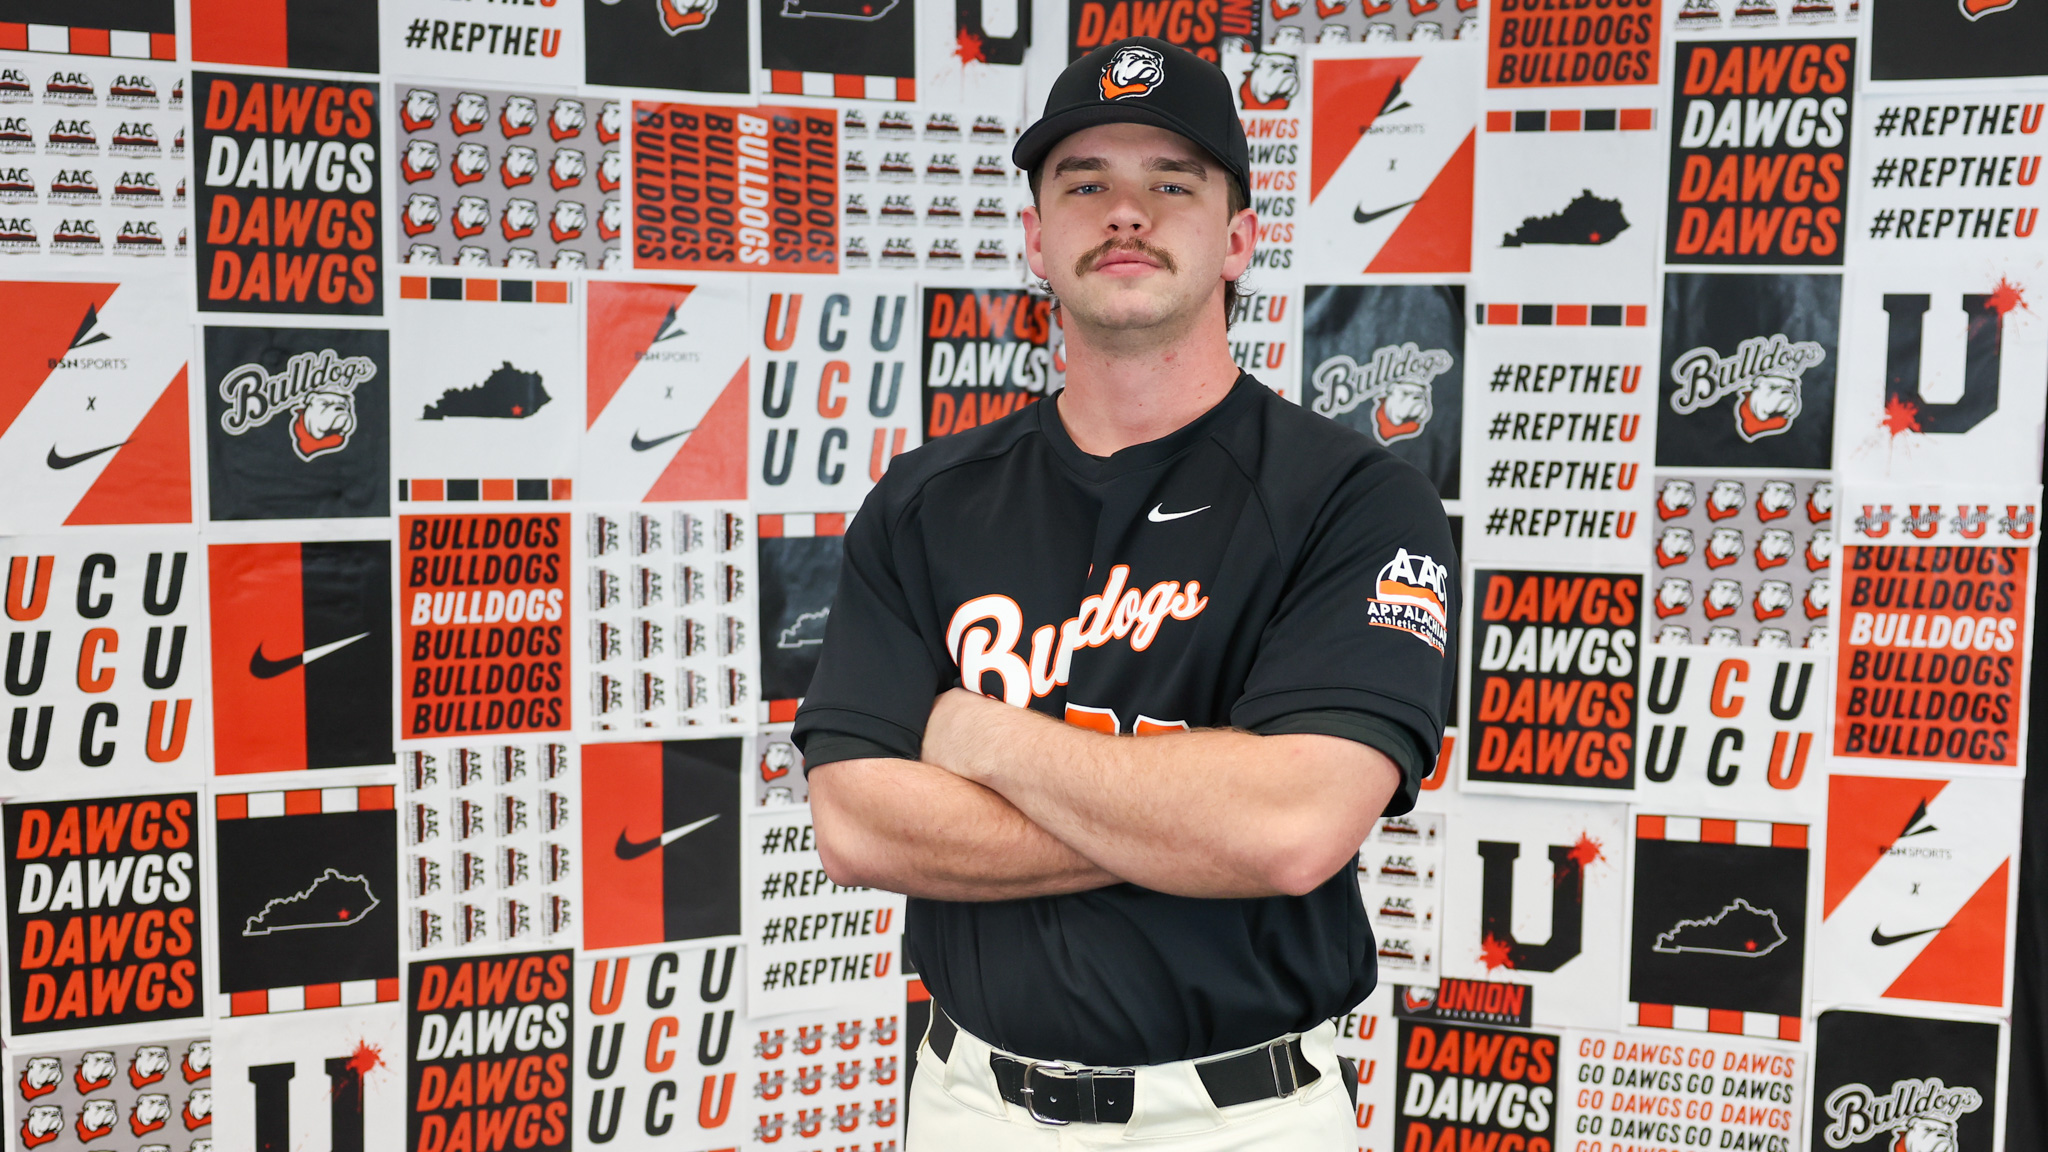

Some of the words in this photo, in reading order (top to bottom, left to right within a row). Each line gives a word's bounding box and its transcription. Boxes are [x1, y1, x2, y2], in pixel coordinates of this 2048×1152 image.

[405, 18, 561, 58] #REPTHEU
[1077, 0, 1219, 47] DAWGS
[1500, 14, 1651, 47] BULLDOGS
[2, 69, 25, 82] AC
[52, 71, 88, 85] AAC
[116, 75, 151, 88] AAC
[1498, 50, 1650, 84] BULLDOGS
[1683, 44, 1850, 95] DAWGS
[0, 117, 26, 132] AC
[55, 119, 91, 135] AAC
[119, 122, 153, 137] AAC
[204, 80, 374, 139] DAWGS
[1680, 97, 1848, 148] DAWGS
[1875, 104, 2045, 137] #REPTHEU
[0, 168, 29, 182] AC
[57, 169, 93, 184] AAC
[120, 171, 155, 186] AAC
[205, 136, 376, 194] DAWGS
[636, 109, 667, 261] BULLDOGS
[670, 110, 701, 262] BULLDOGS
[1677, 153, 1844, 203] DAWGS
[1872, 156, 2042, 188] #REPTHEU
[705, 113, 735, 263] BULLDOGS
[737, 113, 770, 266] BULLDOGS
[772, 115, 802, 263] BULLDOGS
[806, 116, 835, 264] BULLDOGS
[0, 218, 31, 232] AC
[60, 219, 95, 234] AAC
[123, 221, 157, 235] AAC
[207, 195, 376, 251] DAWGS
[1675, 206, 1841, 256] DAWGS
[1870, 208, 2039, 238] #REPTHEU
[208, 251, 377, 305] DAWGS
[220, 349, 376, 434] Bulldogs
[1312, 342, 1453, 418] Bulldogs
[1490, 364, 1642, 394] #REPTHEU
[1670, 334, 1826, 415] Bulldogs
[929, 392, 1041, 437] DAW
[1489, 412, 1640, 442] #REPTHEU
[1487, 461, 1639, 490] #REPTHEU
[409, 517, 560, 550] BULLDOGS
[1486, 509, 1637, 539] #REPTHEU
[409, 554, 560, 587] BULLDOGS
[1388, 548, 1448, 602] AAC
[1853, 546, 2017, 575] BULLDOGS
[411, 588, 563, 626] BULLDOGS
[1482, 575, 1638, 626] DAWGS
[1851, 576, 2015, 612] BULLDOGS
[412, 626, 562, 661] BULLDOGS
[1367, 602, 1447, 646] APPALACHIAN
[1849, 612, 2017, 652] BULLDOGS
[1480, 625, 1636, 677] DAWGS
[1849, 650, 2013, 687] BULLDOGS
[412, 662, 562, 698] BULLDOGS
[1478, 677, 1634, 728] DAWGS
[412, 698, 562, 734] BULLDOGS
[1847, 687, 2010, 724] BULLDOGS
[1477, 727, 1632, 780] DAWGS
[1846, 723, 2008, 761] BULLDOGS
[16, 799, 191, 859] DAWGS
[18, 852, 193, 914] DAWGS
[20, 907, 195, 970] DAWGS
[762, 908, 892, 945] #REPTHEU
[22, 959, 196, 1023] DAWGS
[417, 955, 569, 1011] DAWGS
[764, 952, 891, 990] #REPTHEU
[1437, 978, 1525, 1016] UNION
[416, 1002, 569, 1061] DAWGS
[1405, 1026, 1554, 1084] DAWGS
[1579, 1038, 1605, 1059] GO
[1613, 1041, 1684, 1066] DAWGS
[1688, 1048, 1715, 1069] GO
[1723, 1052, 1795, 1078] DAWGS
[417, 1053, 568, 1111] DAWGS
[1403, 1073, 1553, 1132] DAWGS
[1578, 1064, 1604, 1084] GO
[1612, 1067, 1683, 1092] DAWGS
[1687, 1074, 1713, 1094] GO
[1722, 1078, 1793, 1104] DAWGS
[417, 1101, 567, 1152] DAWGS
[1577, 1089, 1604, 1110] GO
[1611, 1092, 1682, 1118] DAWGS
[1686, 1100, 1713, 1121] GO
[1721, 1104, 1792, 1131] DAWGS
[1824, 1077, 1983, 1149] Bulldogs
[1576, 1115, 1603, 1135] GO
[1610, 1118, 1681, 1143] DAWGS
[1685, 1126, 1712, 1146] GO
[1720, 1130, 1790, 1152] DAWGS
